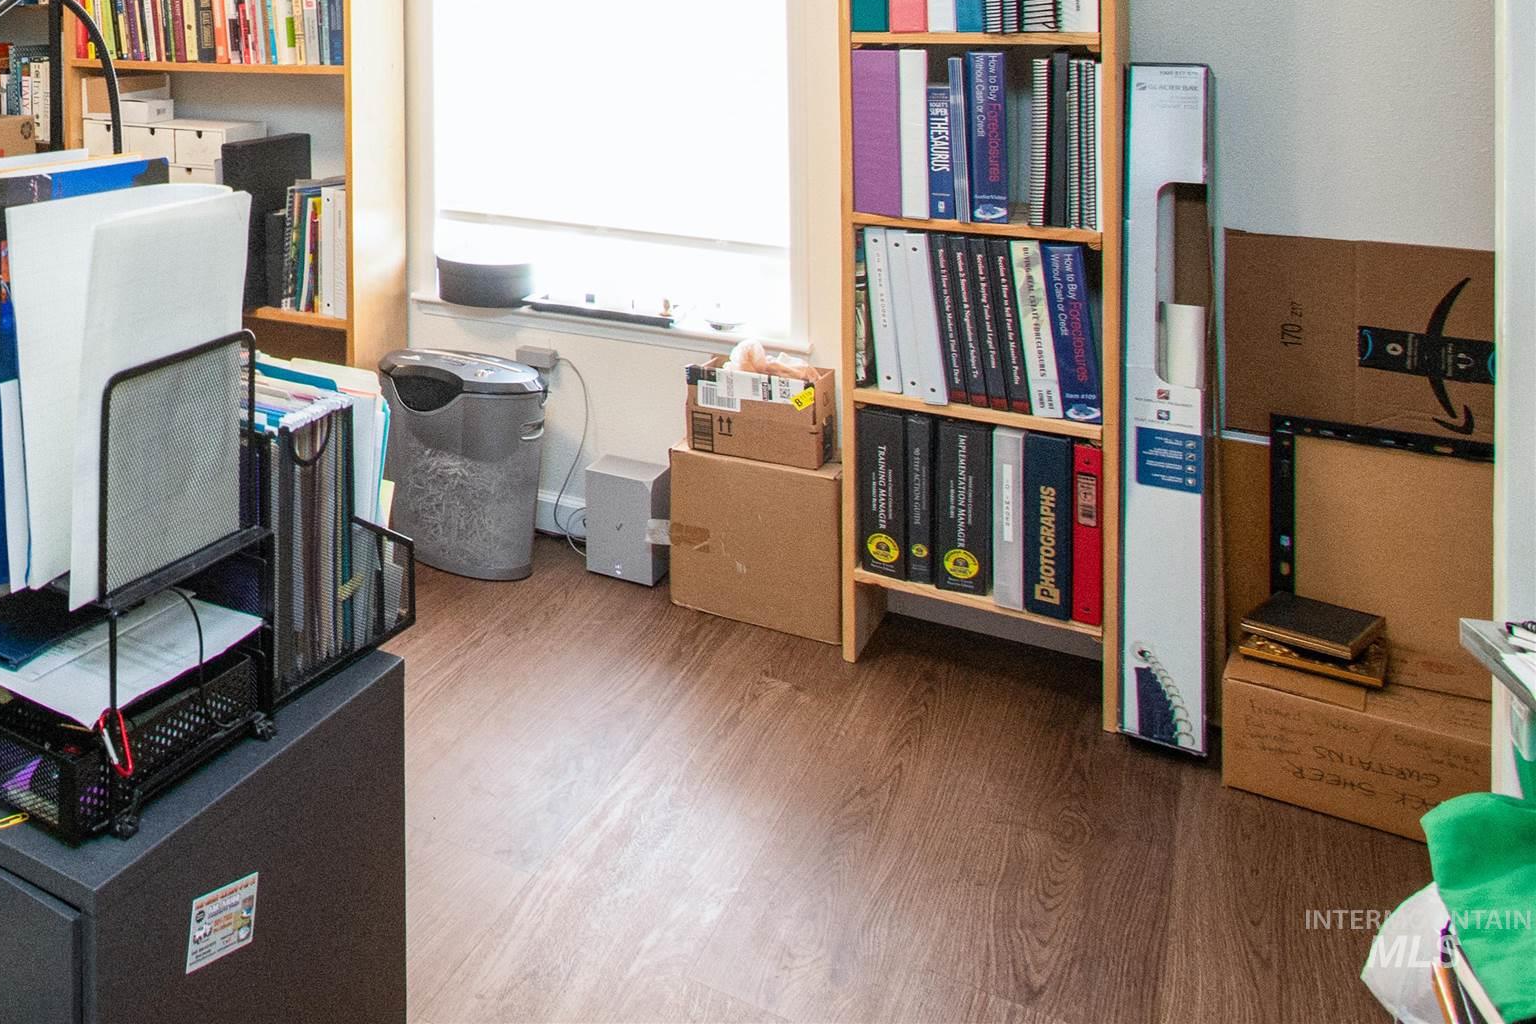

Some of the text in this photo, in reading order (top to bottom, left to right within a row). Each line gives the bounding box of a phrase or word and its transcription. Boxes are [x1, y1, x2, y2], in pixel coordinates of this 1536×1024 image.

[988, 56, 997, 73] How
[21, 79, 30, 109] ITALY
[33, 80, 41, 105] ITALY
[975, 55, 986, 137] Without Cash or Credit
[988, 85, 998, 101] Buy
[929, 117, 950, 172] THESAURUS
[987, 103, 1001, 182] Foreclosures
[938, 249, 946, 268] Section
[956, 252, 965, 271] Section
[976, 254, 984, 274] Section
[997, 256, 1006, 276] Section
[1064, 254, 1075, 272] How
[941, 275, 949, 288] How
[1001, 285, 1009, 298] How
[1066, 283, 1078, 299] Buy
[979, 283, 989, 303] Buying
[1050, 253, 1069, 336] Without Cash or Credit
[943, 296, 952, 311] Niche
[983, 304, 992, 320] Tools
[1004, 307, 1012, 317] Sell
[1022, 247, 1047, 377] BUYING REAL ESTATE FORECLOSURES
[945, 313, 954, 332] Market
[963, 310, 974, 341] Negotiation
[1005, 318, 1014, 331] Fast
[985, 333, 995, 350] Legal
[1007, 332, 1015, 340] for
[1069, 301, 1089, 382] Foreclosures
[1280, 323, 1303, 347] 170
[949, 340, 957, 352] Find
[1008, 341, 1018, 364] Massive
[951, 353, 959, 368] Good
[968, 349, 977, 369] Subject
[989, 352, 997, 368] Forms
[953, 369, 961, 384] Deals
[1012, 366, 1020, 384] Profits
[1046, 389, 1055, 410] ALBERT
[1065, 392, 1079, 401] Item
[878, 445, 886, 486] TRAINING
[957, 434, 967, 548] IMPLEMENTATION MANAGER
[913, 503, 921, 524] GUIDE
[1035, 486, 1060, 605] PHOTOGRAPHS
[1312, 745, 1441, 789] CURTAINS
[1285, 761, 1376, 797] SHEER
